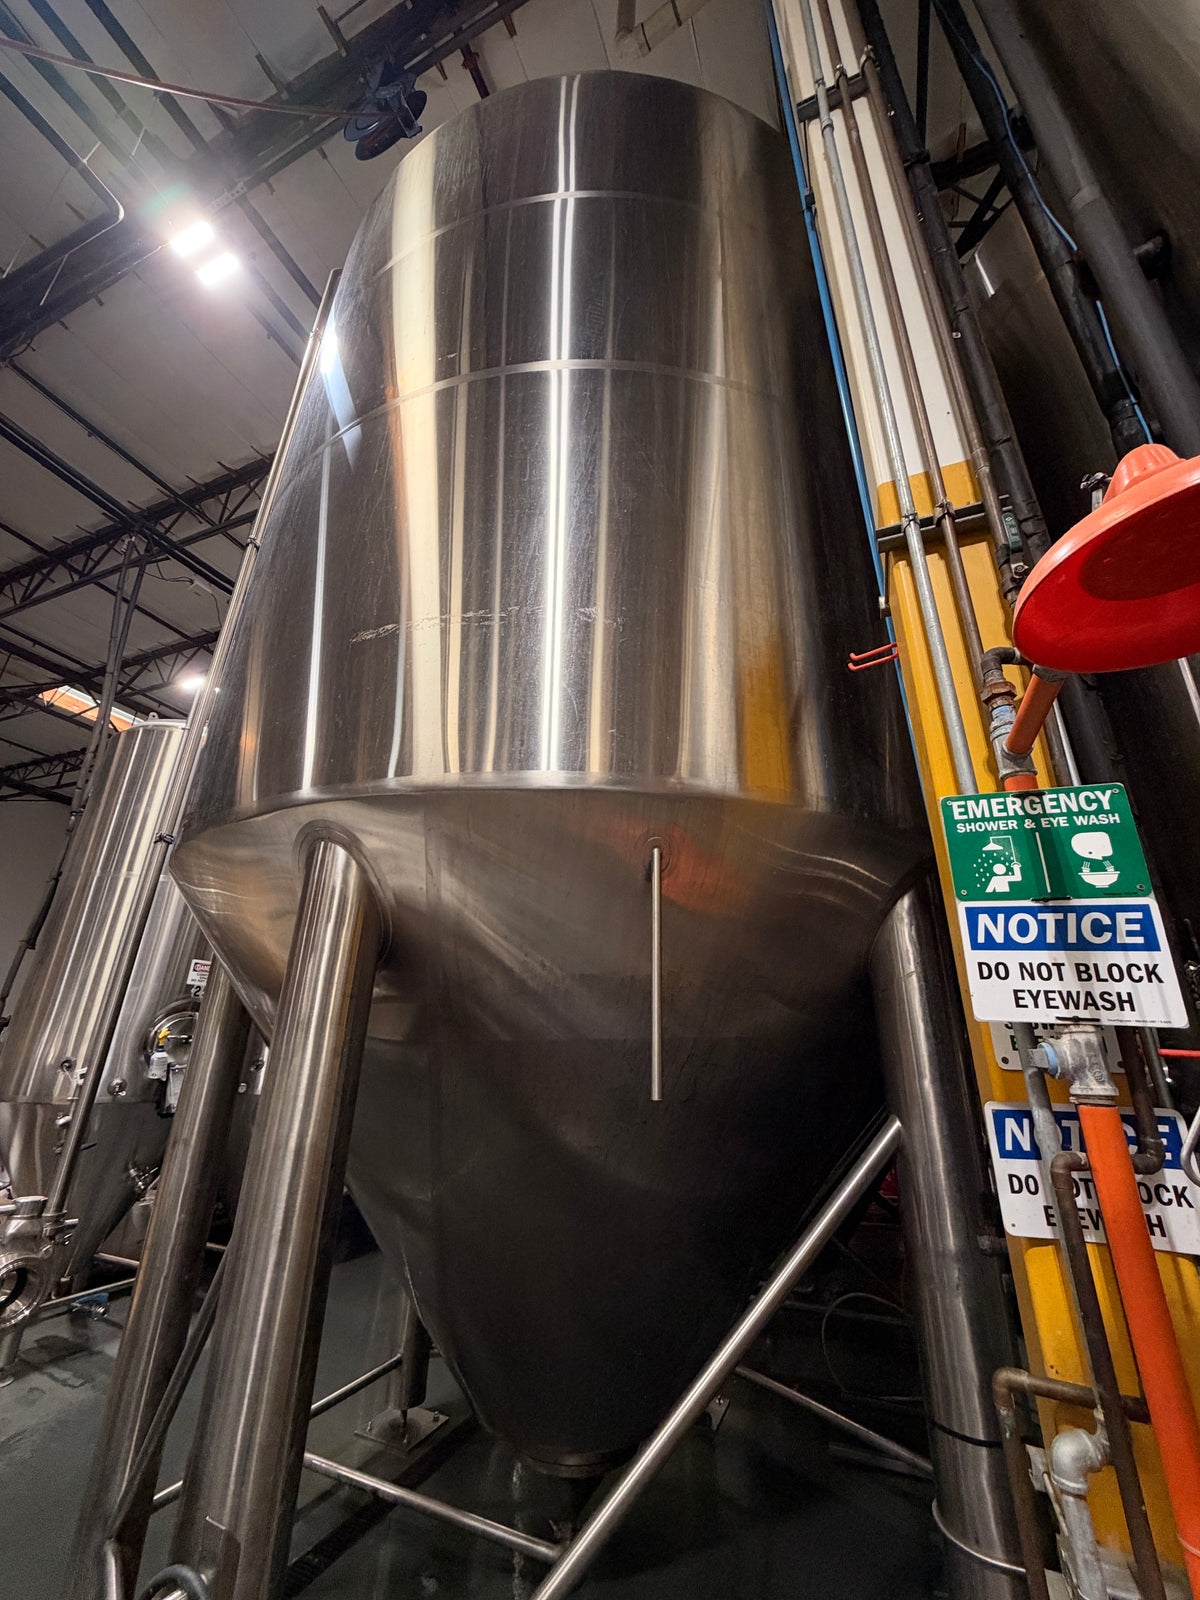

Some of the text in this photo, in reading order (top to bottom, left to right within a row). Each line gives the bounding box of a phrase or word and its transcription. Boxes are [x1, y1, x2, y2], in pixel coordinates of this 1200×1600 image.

[951, 790, 1113, 820] EMERGENCY
[956, 813, 1121, 833] SHOWER & EYE WASH
[977, 911, 1145, 944] NOTICE
[977, 961, 1164, 984] DO NOT BLOCK
[1013, 988, 1136, 1012] EYEWASH
[1004, 1118, 1172, 1160] NTC
[1008, 1173, 1039, 1196] DO
[1137, 1181, 1195, 1209] OCK
[1043, 1204, 1167, 1238] EEWH
